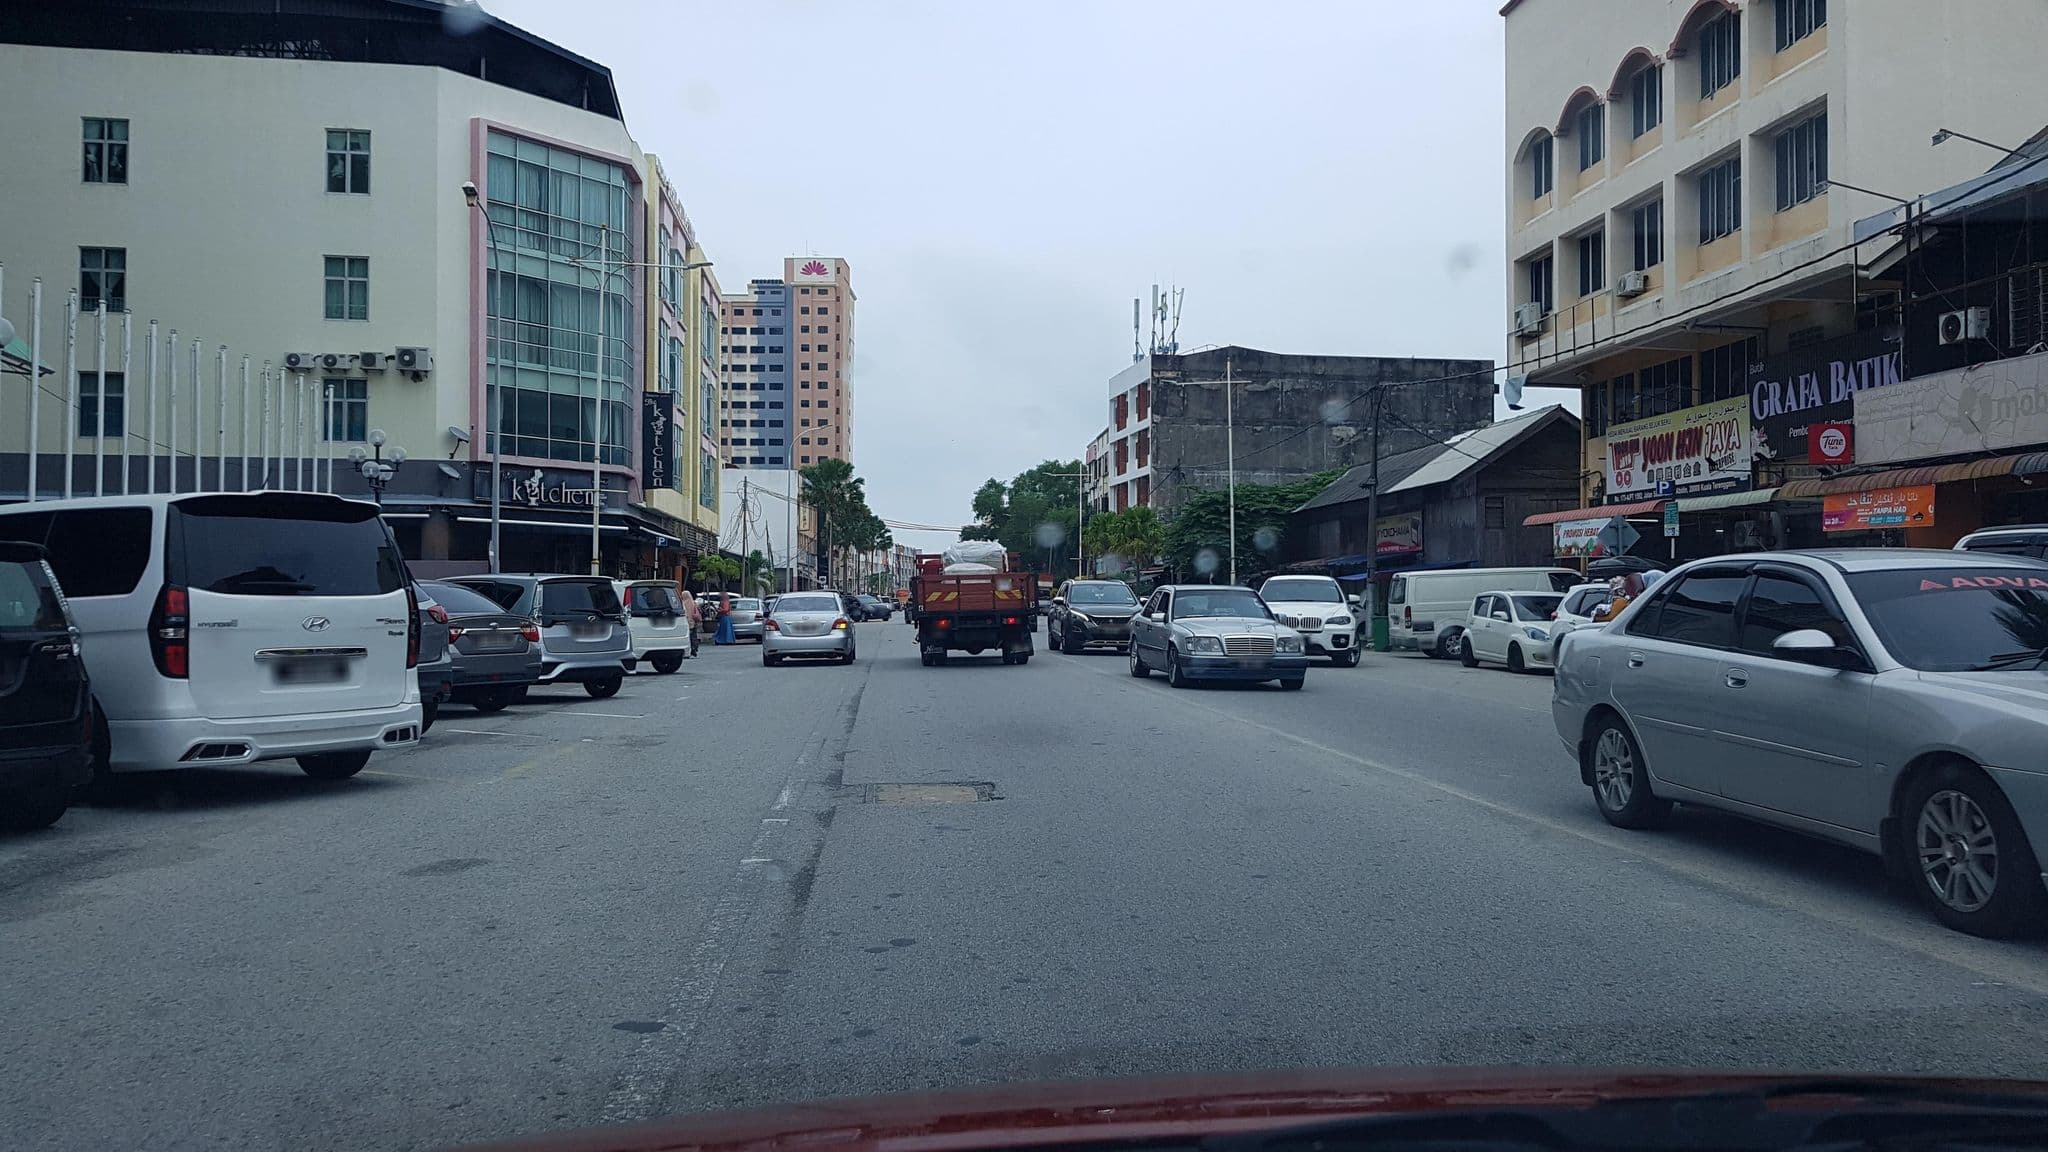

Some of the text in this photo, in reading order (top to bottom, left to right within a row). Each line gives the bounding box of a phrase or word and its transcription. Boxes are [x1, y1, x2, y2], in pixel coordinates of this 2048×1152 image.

[1752, 371, 1824, 421] GRAFA
[1829, 351, 1901, 403] BATIK
[1641, 432, 1675, 472] YOON
[1705, 417, 1741, 459] JAYA
[1821, 435, 1844, 449] Tune
[1659, 481, 1670, 495] P
[1893, 505, 1907, 514] HAD
[658, 537, 666, 545] P
